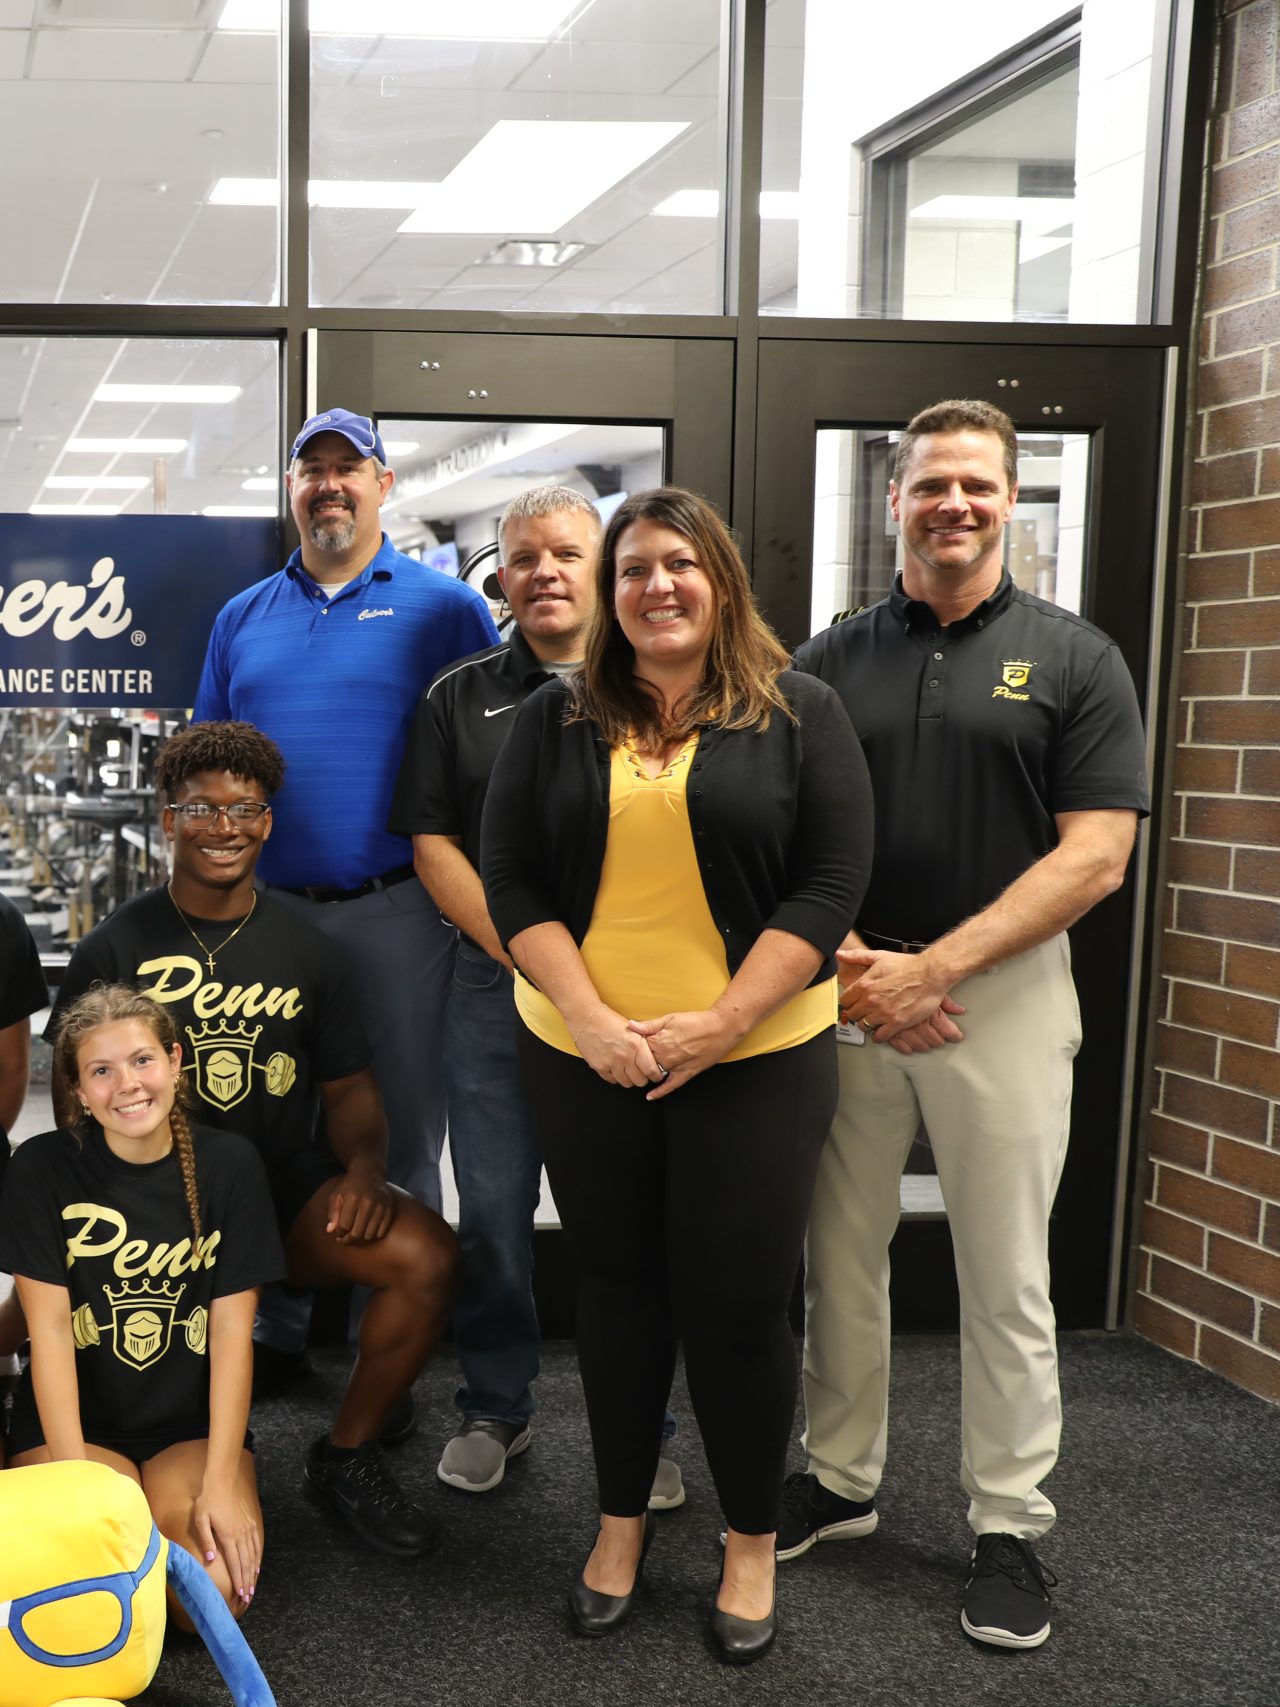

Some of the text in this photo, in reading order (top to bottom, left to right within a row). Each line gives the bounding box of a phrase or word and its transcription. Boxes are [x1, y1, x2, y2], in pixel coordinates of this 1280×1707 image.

[61, 668, 153, 694] CENTER
[991, 686, 1030, 701] Penn
[136, 955, 303, 1019] Penn
[61, 1203, 221, 1279] Penn
